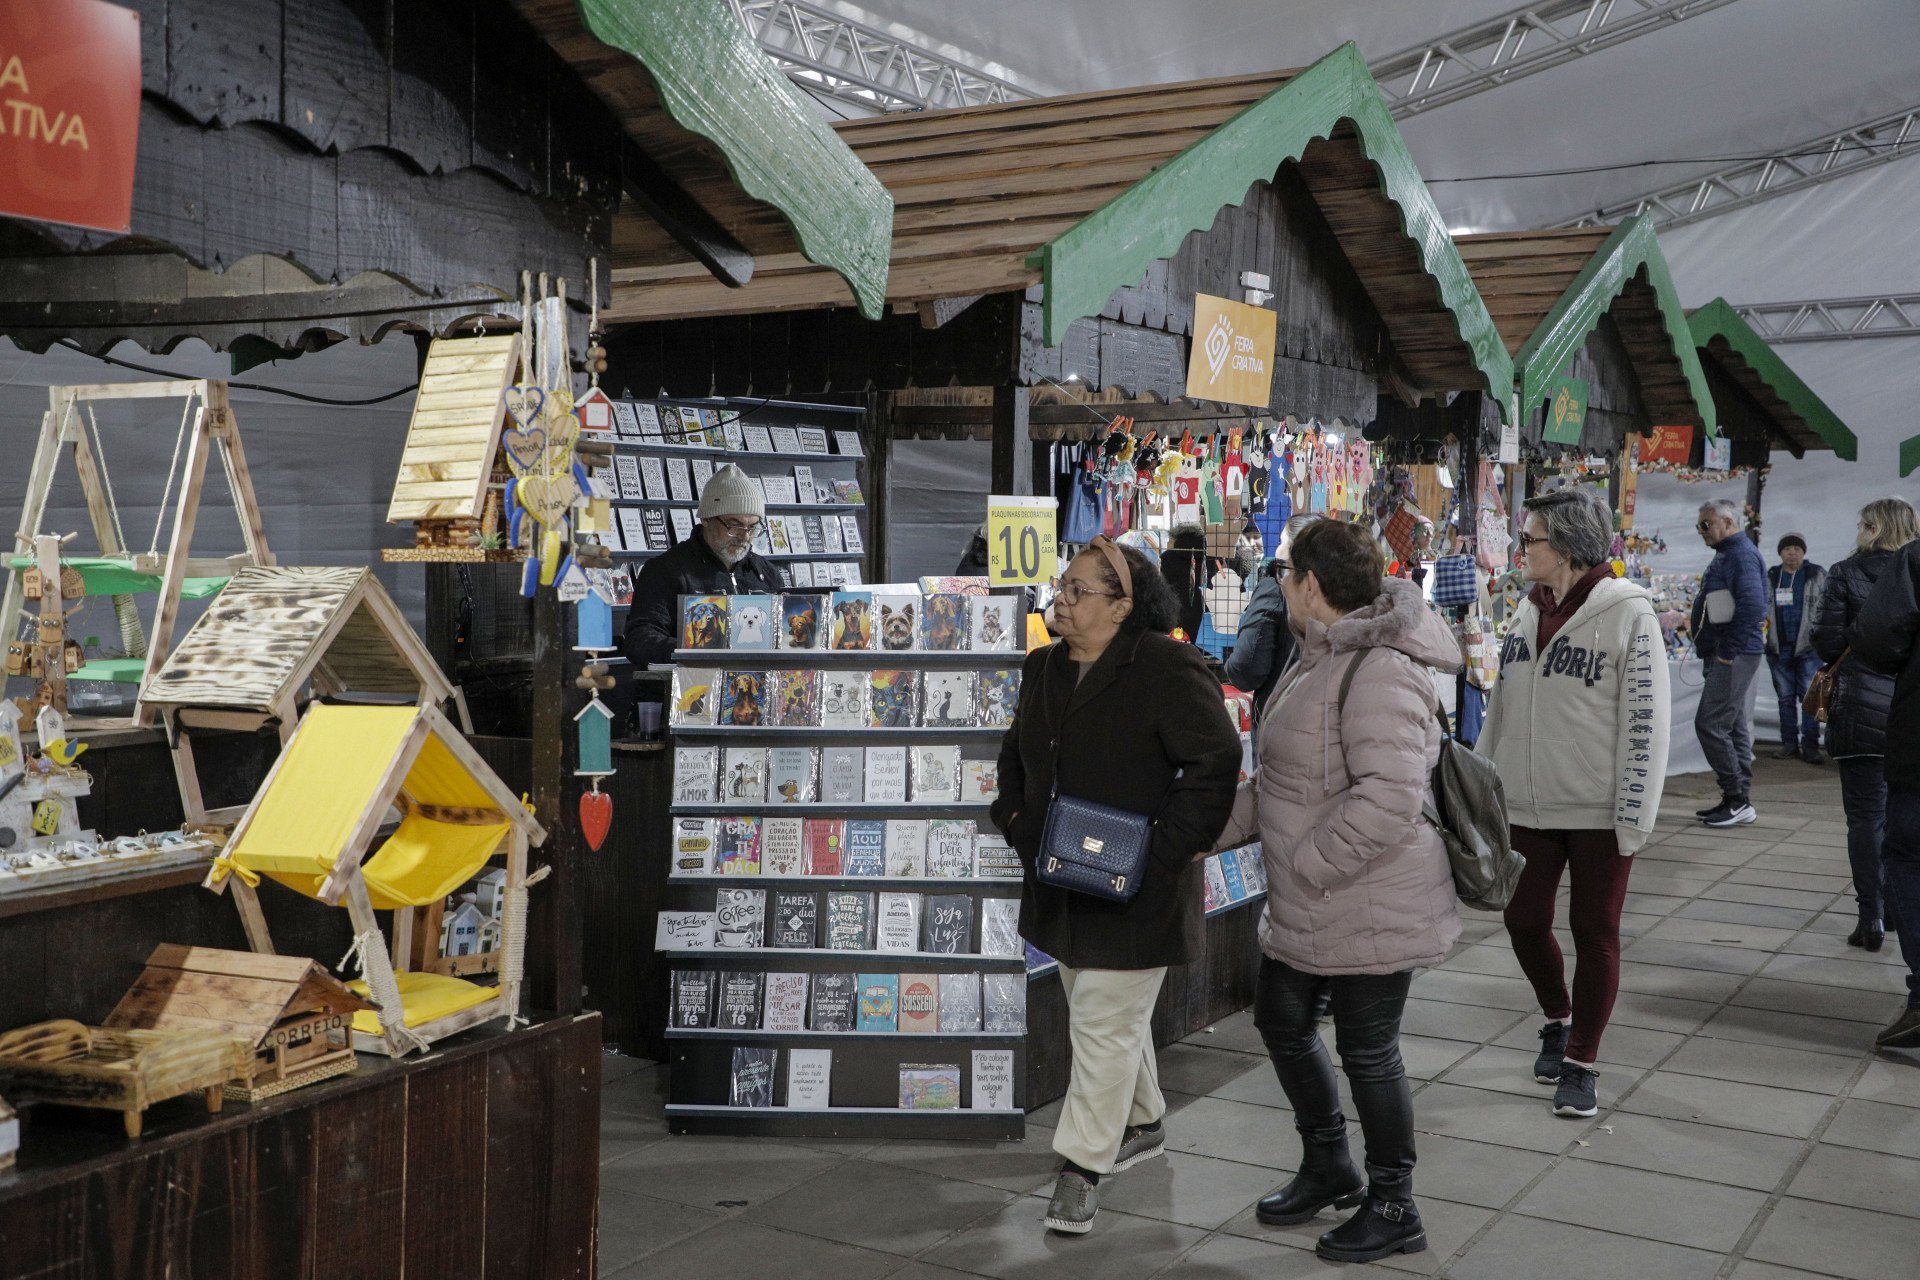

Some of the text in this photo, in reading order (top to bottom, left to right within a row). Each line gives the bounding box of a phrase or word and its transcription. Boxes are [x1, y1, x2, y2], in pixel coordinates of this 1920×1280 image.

[1234, 335, 1254, 354] FEIRA
[1231, 354, 1264, 374] CRIATIVA
[645, 509, 662, 520] NÃO
[991, 510, 1020, 518] PLAQUINHAS
[999, 526, 1040, 578] 10
[1041, 546, 1055, 554] CADA
[871, 751, 903, 766] Obrigado
[874, 763, 900, 774] Senhor
[872, 779, 902, 789] por mais
[680, 788, 708, 802] AMOR
[870, 792, 882, 800] um
[726, 821, 758, 835] GRA
[769, 828, 797, 836] CORAÇÃO
[681, 839, 707, 848] CAMINHO
[851, 835, 882, 845] AQUI
[940, 842, 962, 856] Deus
[778, 896, 814, 906] TAREFA
[718, 905, 756, 926] Coffee
[782, 932, 808, 943] FELIZ
[886, 940, 910, 948] VIDAS
[776, 976, 803, 994] PRECISO
[678, 1003, 706, 1012] minha
[726, 1002, 754, 1012] minha
[768, 1002, 801, 1012] PULSAR
[684, 1012, 698, 1026] fé
[731, 1012, 746, 1025] fé
[264, 1015, 342, 1049] CORREIO
[976, 1074, 988, 1082] seus
[737, 1076, 768, 1092] amigos
[982, 1084, 1002, 1093] coloque
